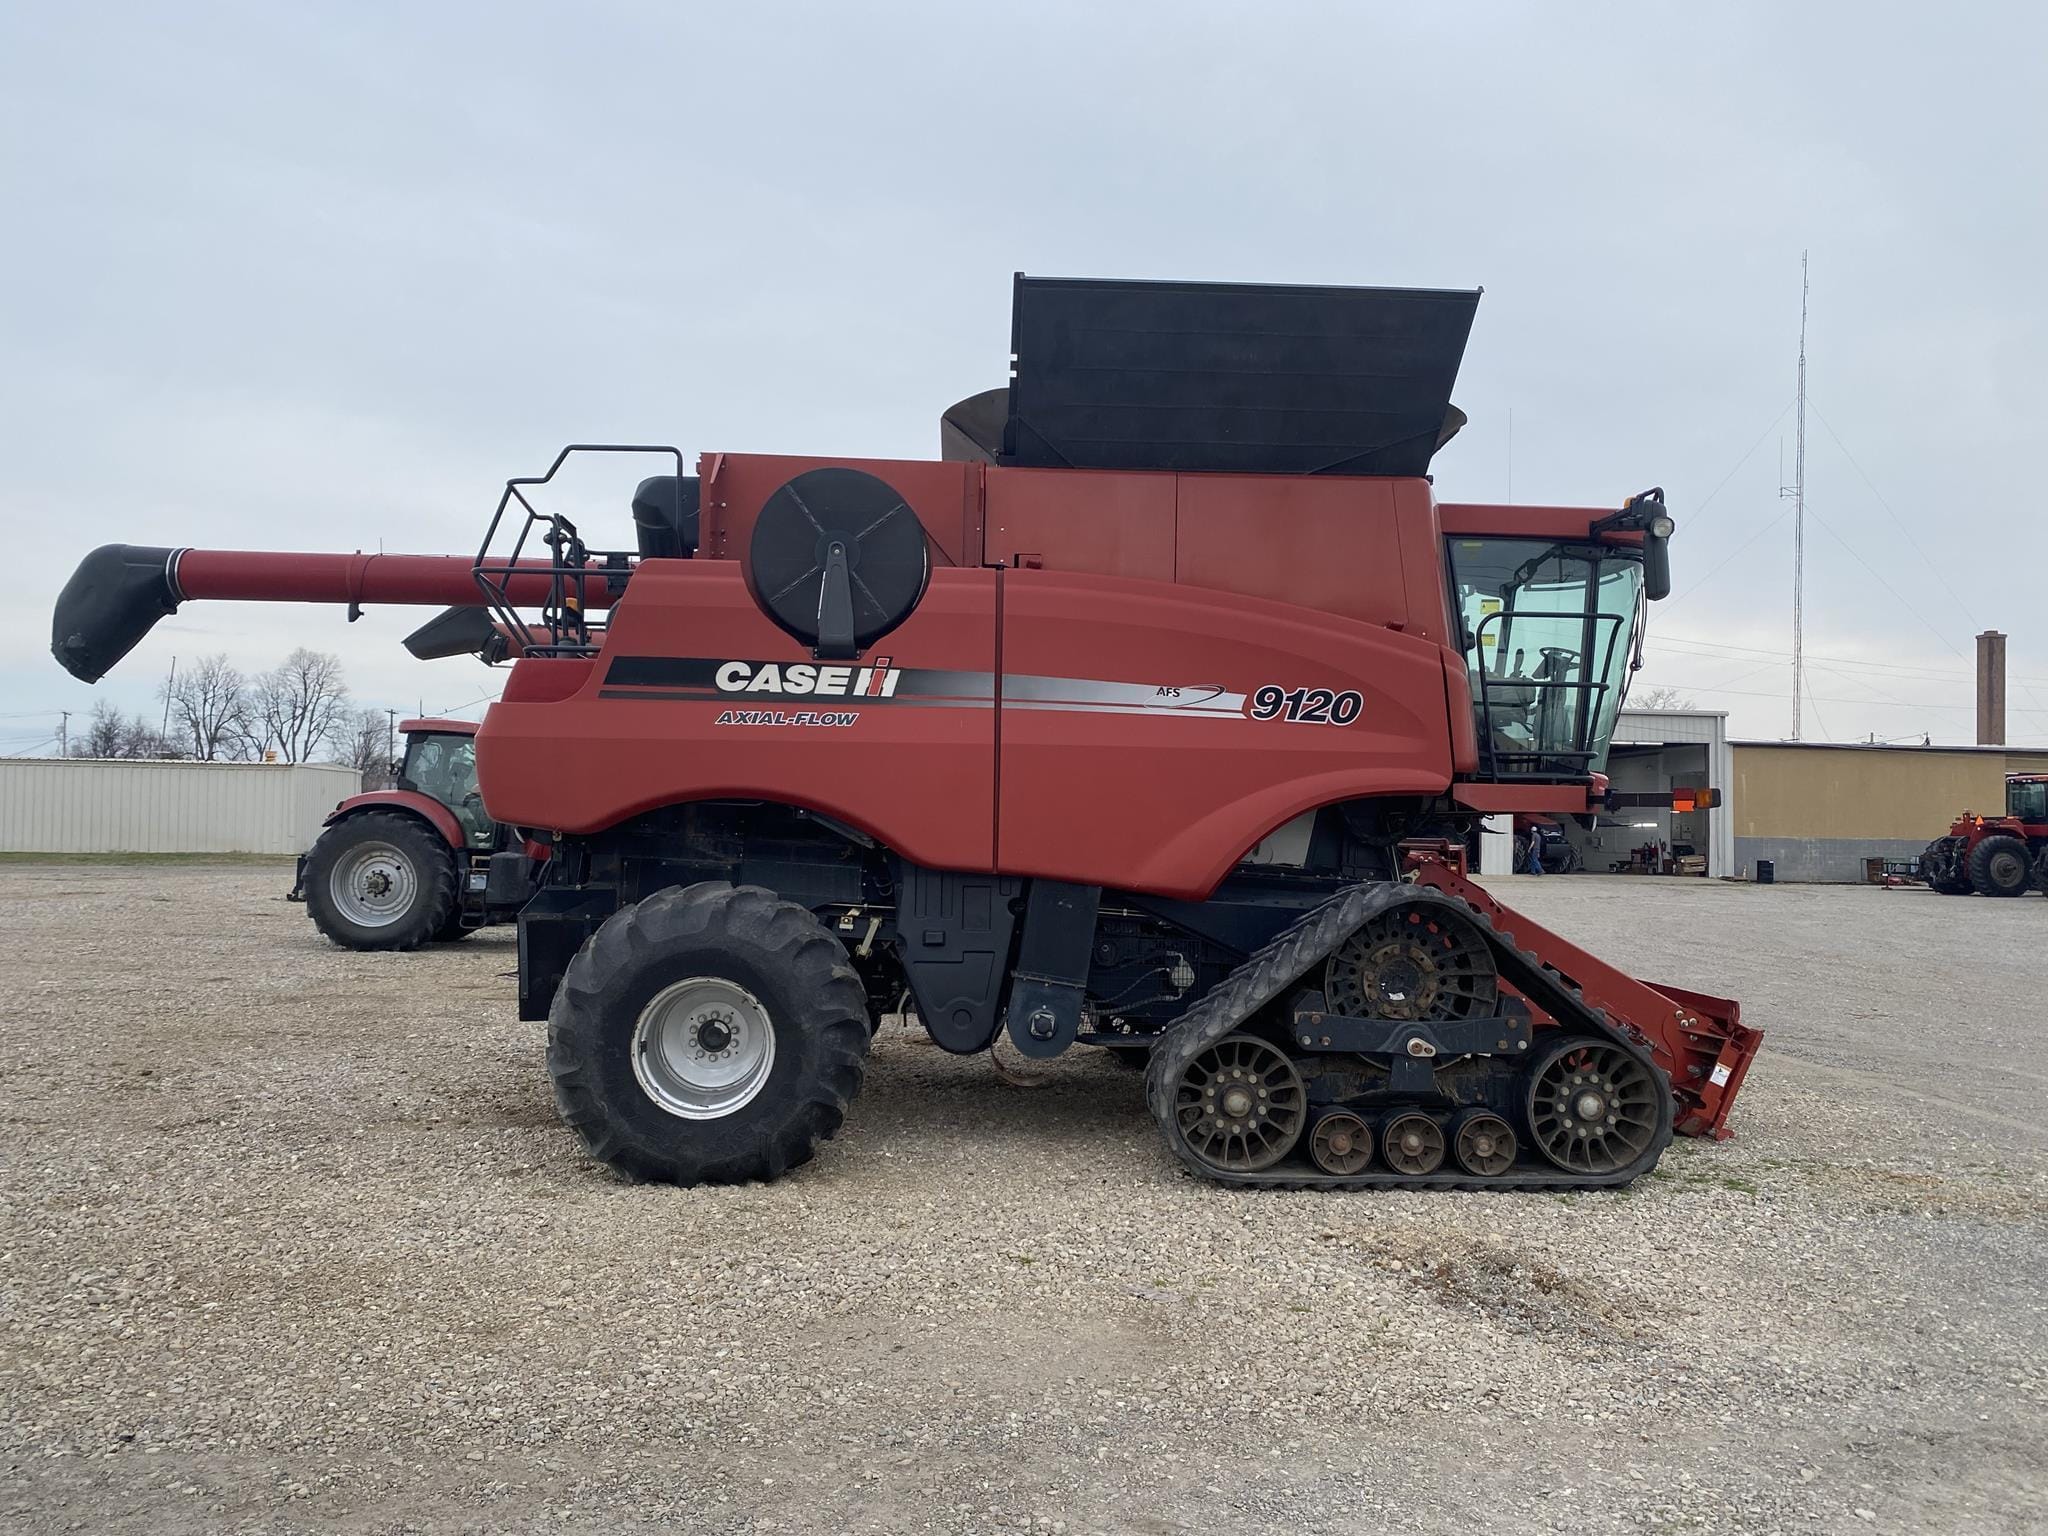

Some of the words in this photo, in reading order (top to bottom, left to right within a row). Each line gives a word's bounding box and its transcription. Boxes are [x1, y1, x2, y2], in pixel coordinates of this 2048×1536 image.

[715, 662, 851, 695] CASE
[1156, 686, 1181, 698] AFS
[1250, 685, 1363, 726] 9120
[715, 711, 859, 727] AXIAL-FLOW
